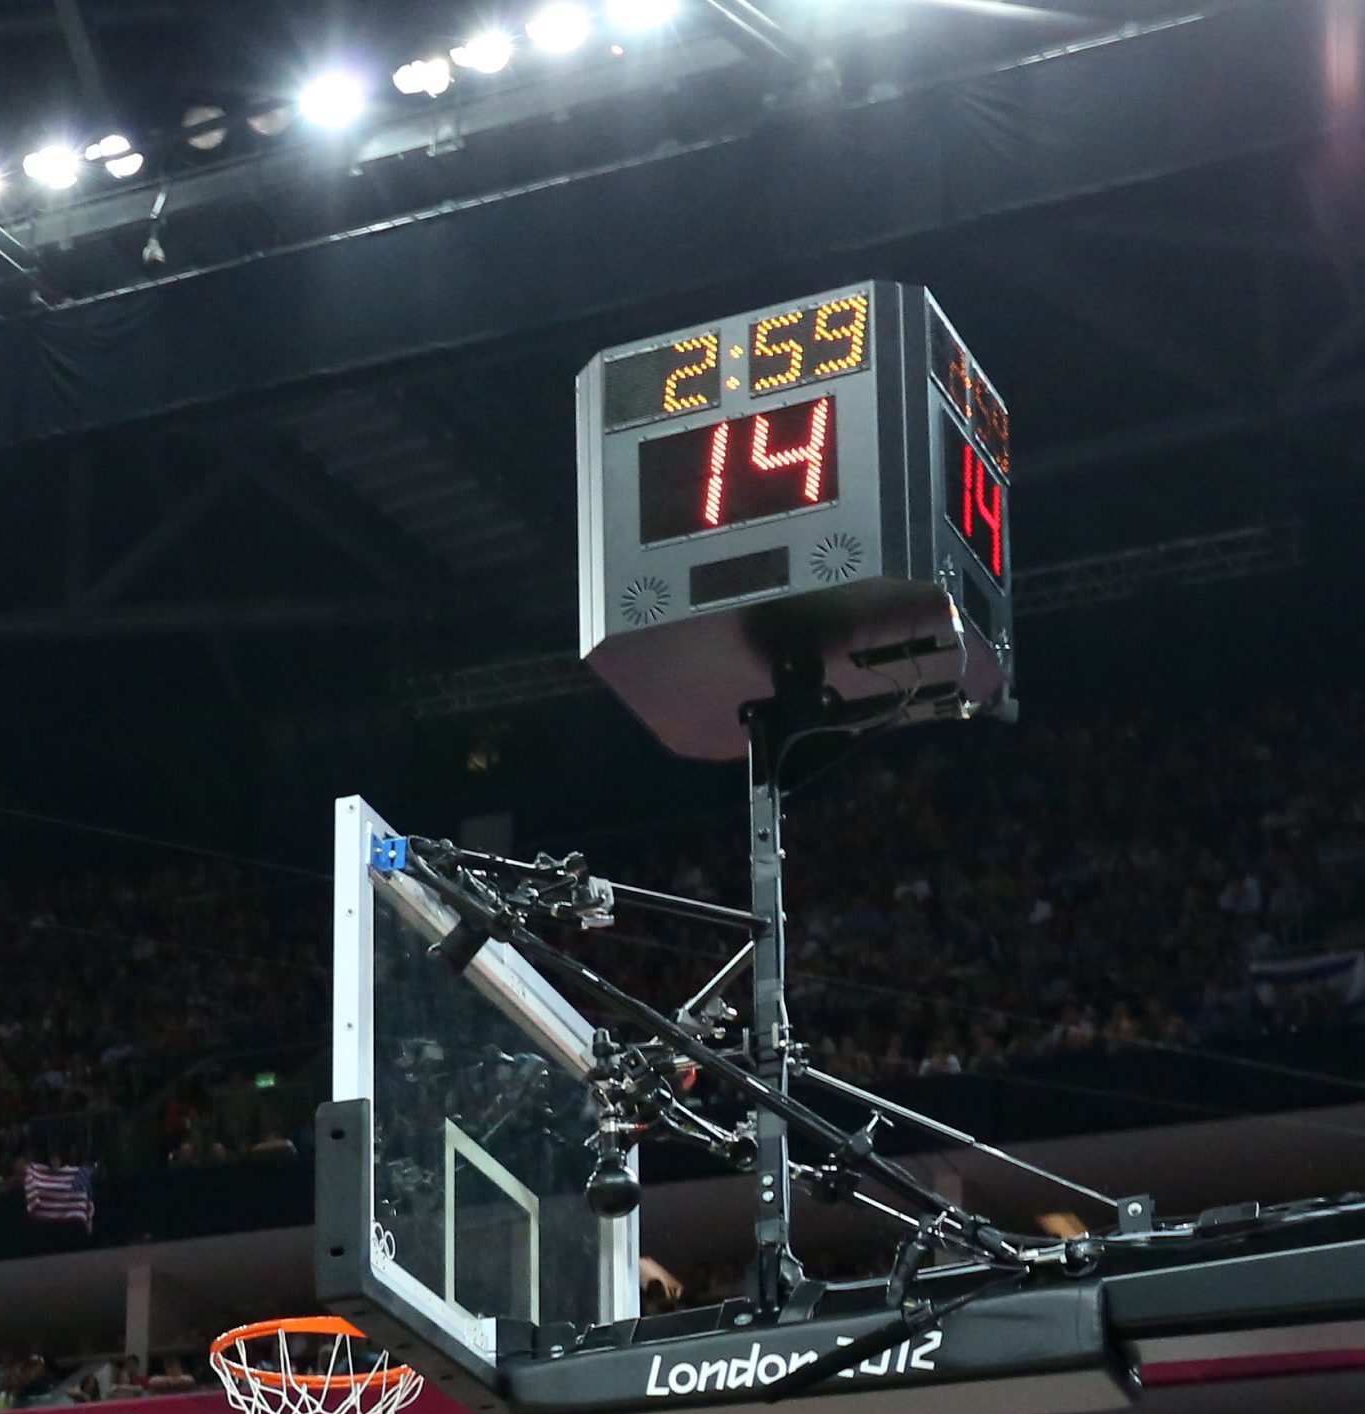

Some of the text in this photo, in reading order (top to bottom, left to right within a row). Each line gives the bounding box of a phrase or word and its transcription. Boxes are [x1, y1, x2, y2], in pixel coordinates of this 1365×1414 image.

[663, 294, 869, 414] 2:59
[703, 396, 831, 527] 14
[962, 443, 1002, 578] 14
